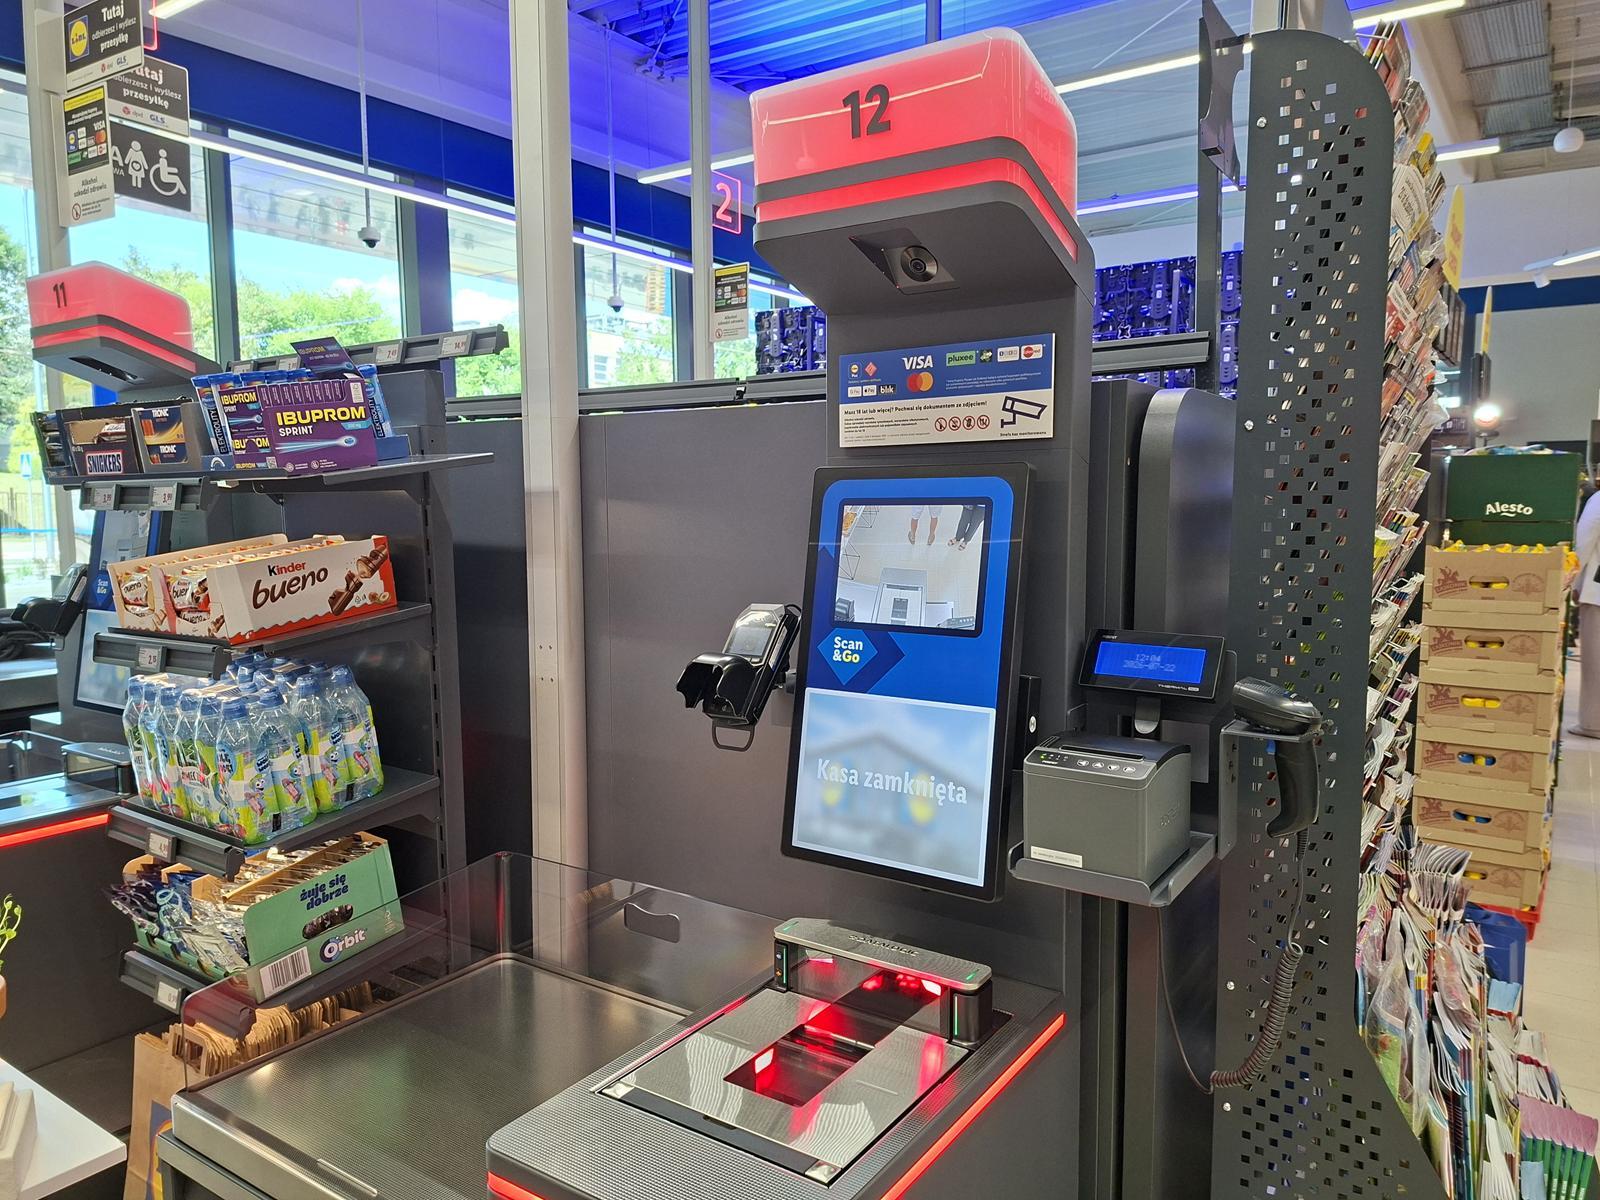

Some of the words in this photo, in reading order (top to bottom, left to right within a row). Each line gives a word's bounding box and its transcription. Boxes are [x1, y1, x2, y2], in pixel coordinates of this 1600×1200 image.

[102, 0, 124, 21] Tutaj
[101, 33, 128, 53] przesyłkę
[116, 56, 127, 65] GLS
[131, 67, 163, 84] utaj
[123, 88, 169, 109] przesyłkę
[154, 86, 182, 100] wyślesz
[150, 114, 166, 124] GLS
[843, 84, 891, 139] 12
[82, 176, 98, 187] Alkohol
[53, 282, 68, 308] 11
[902, 355, 934, 370] VISA
[948, 354, 974, 364] pluxee
[880, 386, 894, 394] blik
[221, 392, 258, 406] IBUPROM
[276, 406, 366, 426] IBUPROM
[278, 425, 314, 438] SPRINT
[232, 438, 270, 450] IBUOM
[87, 453, 122, 472] SNICKERS
[1485, 502, 1534, 518] Alesto
[268, 562, 306, 576] Kinder
[98, 578, 108, 586] Scan
[252, 568, 328, 610] bueno
[833, 636, 864, 651] Scan
[832, 650, 860, 664] &Go
[817, 759, 859, 786] Kasa
[864, 771, 968, 806] zamknięta
[300, 882, 326, 902] żuje
[328, 874, 346, 886] się
[306, 884, 348, 910] dobrze
[324, 930, 366, 958] Orbit
